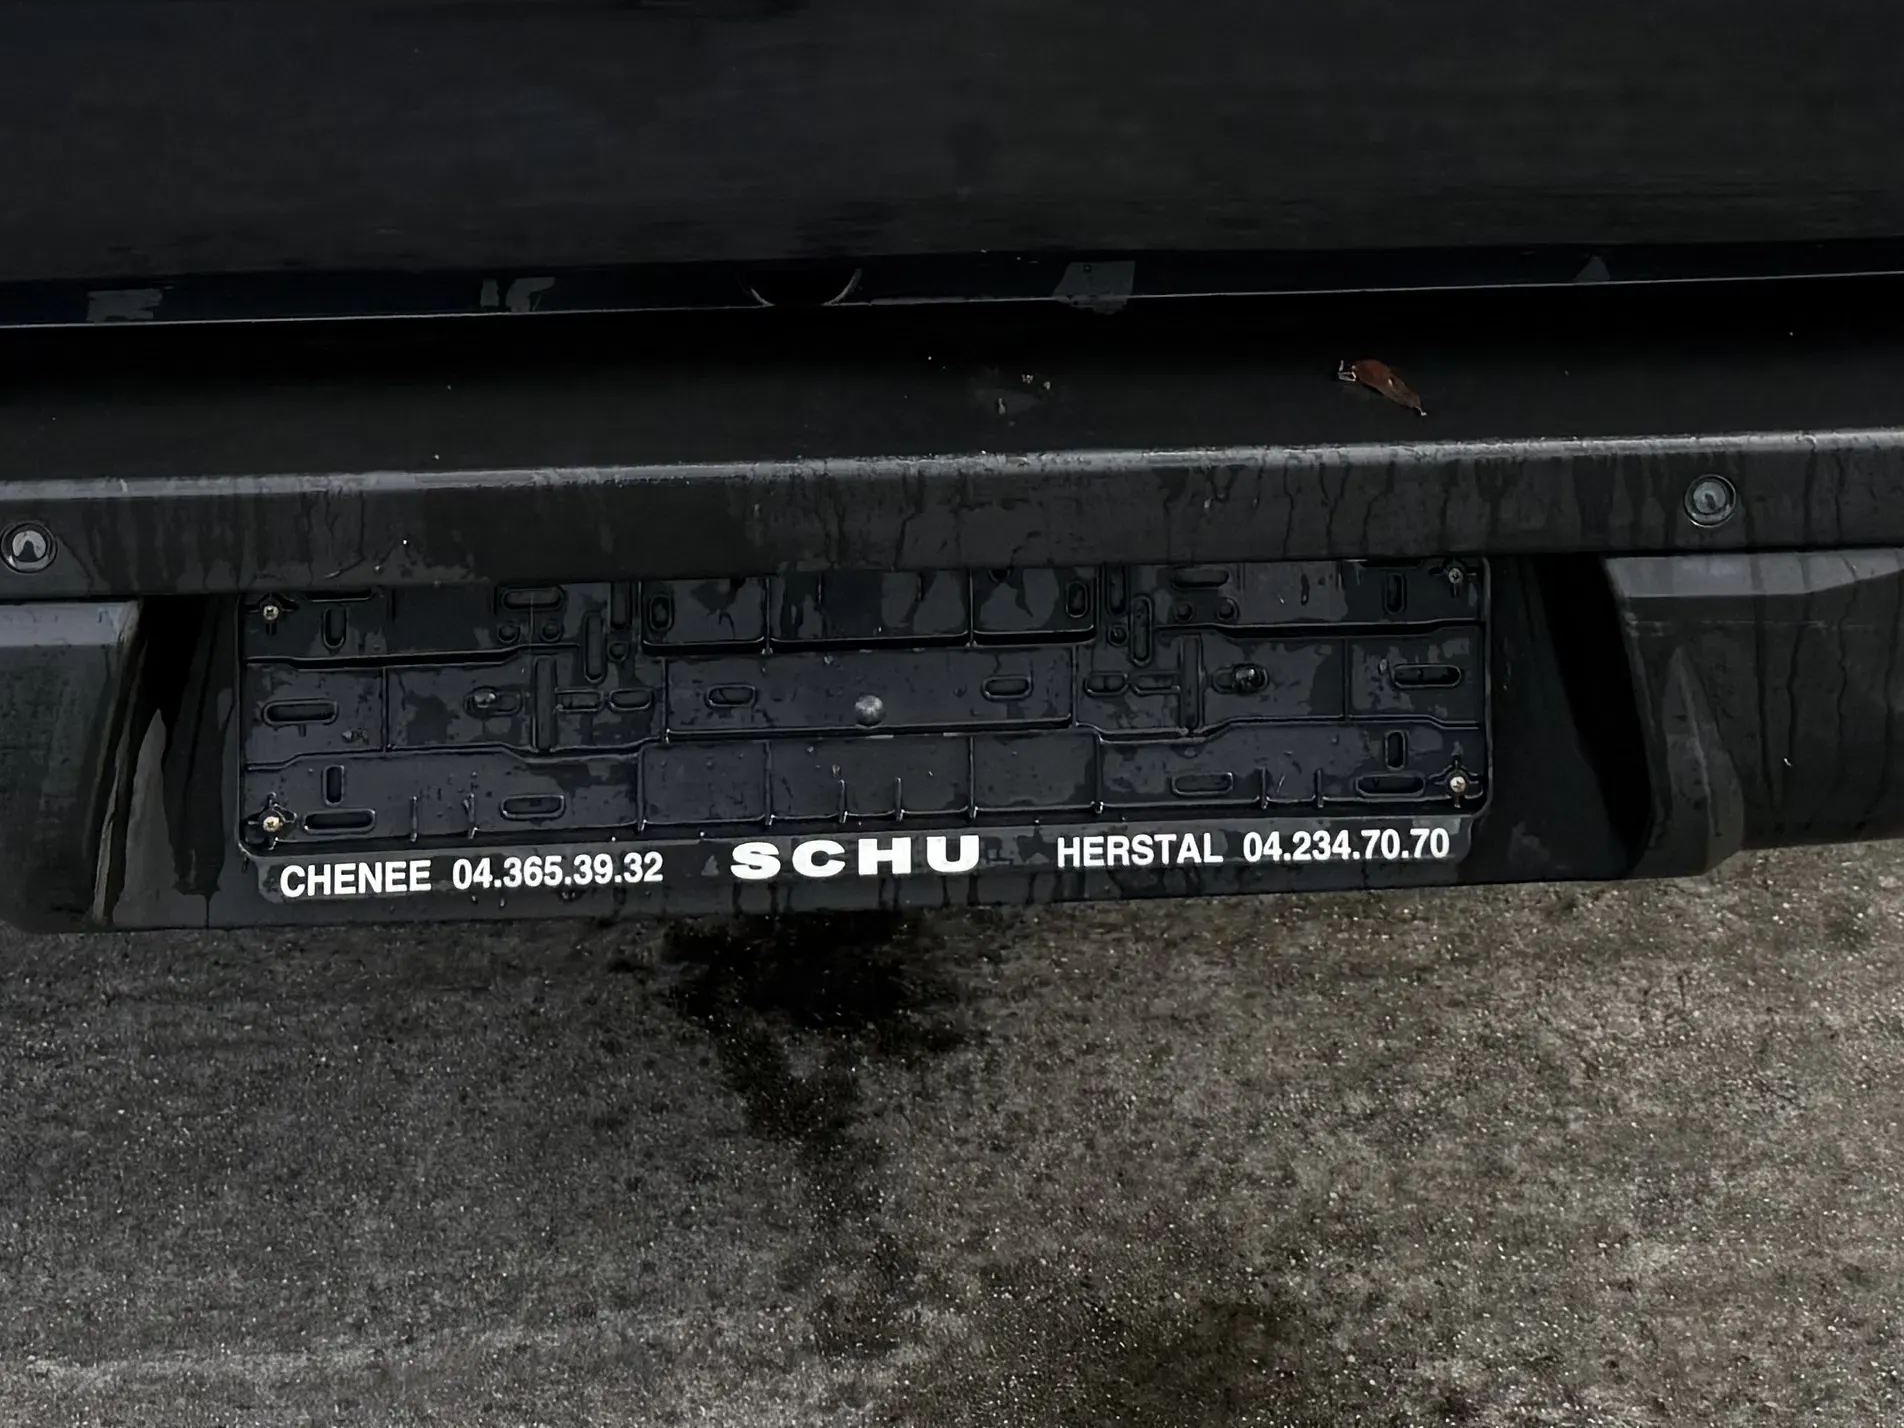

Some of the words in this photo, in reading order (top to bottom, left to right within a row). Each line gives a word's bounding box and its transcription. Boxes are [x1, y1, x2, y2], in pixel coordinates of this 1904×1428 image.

[280, 859, 432, 898] CHENEE
[452, 851, 664, 890] 04.365.39.32
[730, 834, 980, 880] SCHU
[1057, 832, 1224, 869] HERSTAL
[1243, 827, 1450, 863] 04.234.70.70
